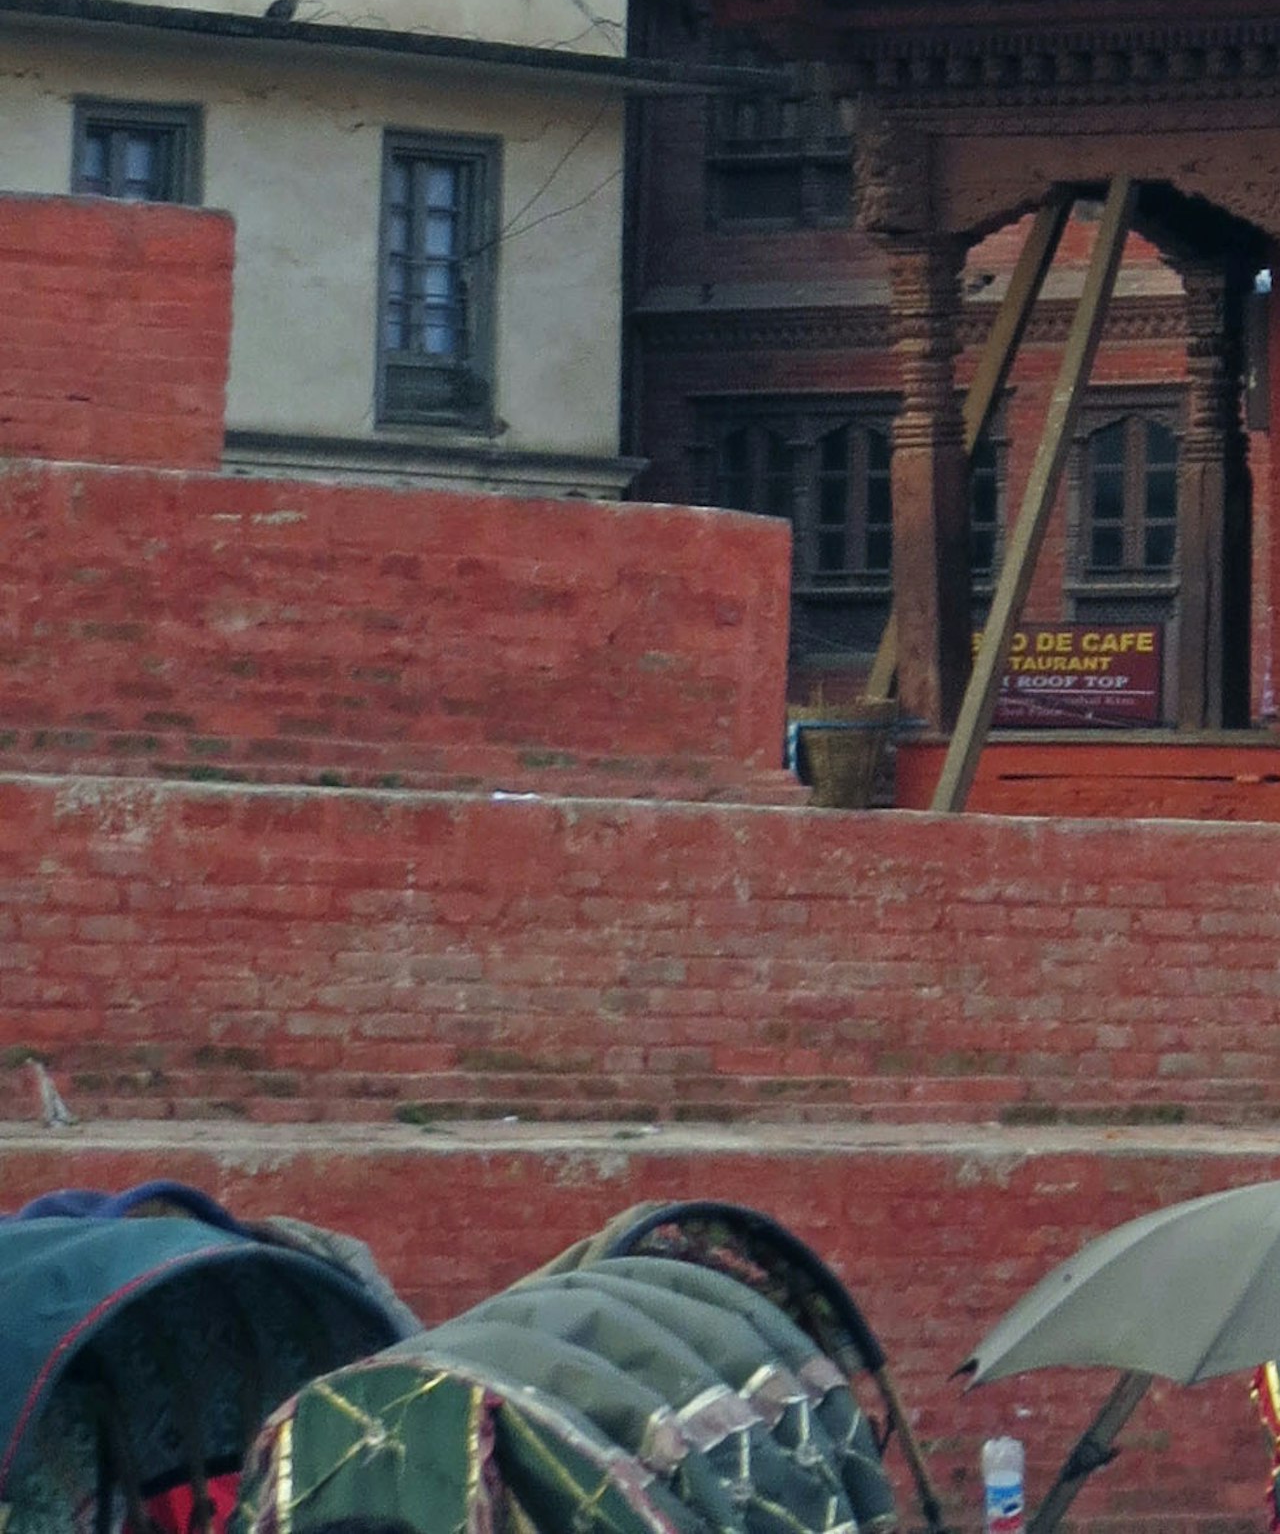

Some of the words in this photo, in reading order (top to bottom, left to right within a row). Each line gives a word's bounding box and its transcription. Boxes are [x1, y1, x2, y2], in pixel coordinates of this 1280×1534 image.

[1036, 633, 1074, 652] DE
[1083, 633, 1154, 652] CAFE
[971, 656, 1112, 671] TAURANT
[1083, 676, 1129, 689] TOP
